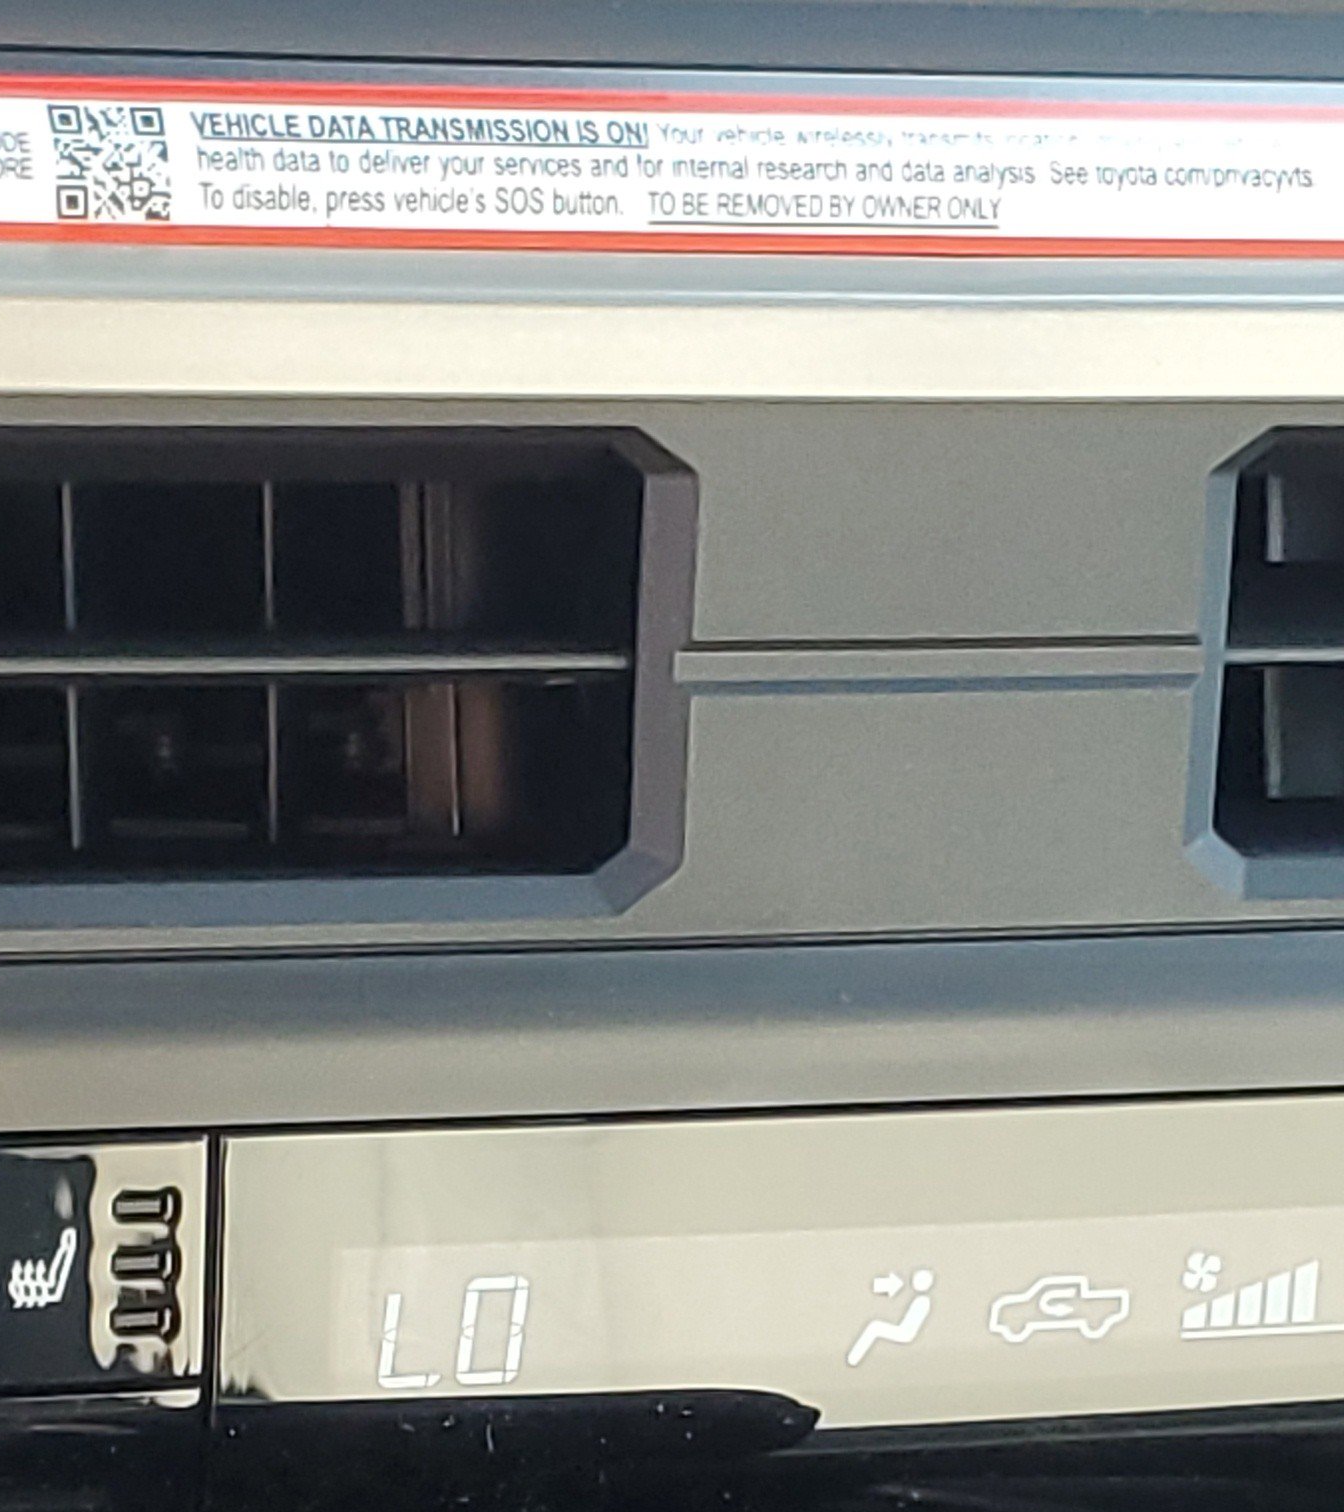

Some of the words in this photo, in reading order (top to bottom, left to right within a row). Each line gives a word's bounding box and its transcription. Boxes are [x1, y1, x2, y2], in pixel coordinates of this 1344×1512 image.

[190, 111, 302, 139] VEHICLE
[308, 114, 376, 140] DATA
[379, 116, 569, 143] TRANSMISSION
[576, 118, 599, 144] IS
[607, 119, 649, 146] ON!
[657, 123, 703, 144] Your
[197, 146, 265, 172] health
[272, 147, 321, 173] data
[329, 149, 350, 173] to
[358, 149, 430, 174] deliver
[438, 154, 485, 181] your
[493, 155, 582, 178] services
[589, 155, 628, 178] and
[636, 153, 663, 179] for
[671, 155, 748, 180] internal
[757, 159, 847, 181] research
[855, 160, 893, 183] and
[901, 159, 945, 183] data
[953, 162, 1036, 190] analysis
[1049, 160, 1088, 186] See
[198, 181, 224, 211] To
[326, 189, 385, 220] press
[393, 186, 486, 214] vehicle's
[495, 186, 544, 214] SOS
[648, 190, 676, 216] TO
[682, 191, 709, 217] BE
[716, 192, 823, 218] REMOVED
[829, 193, 856, 219] BY
[861, 193, 941, 220] OWNER
[947, 195, 1002, 220] ONLY
